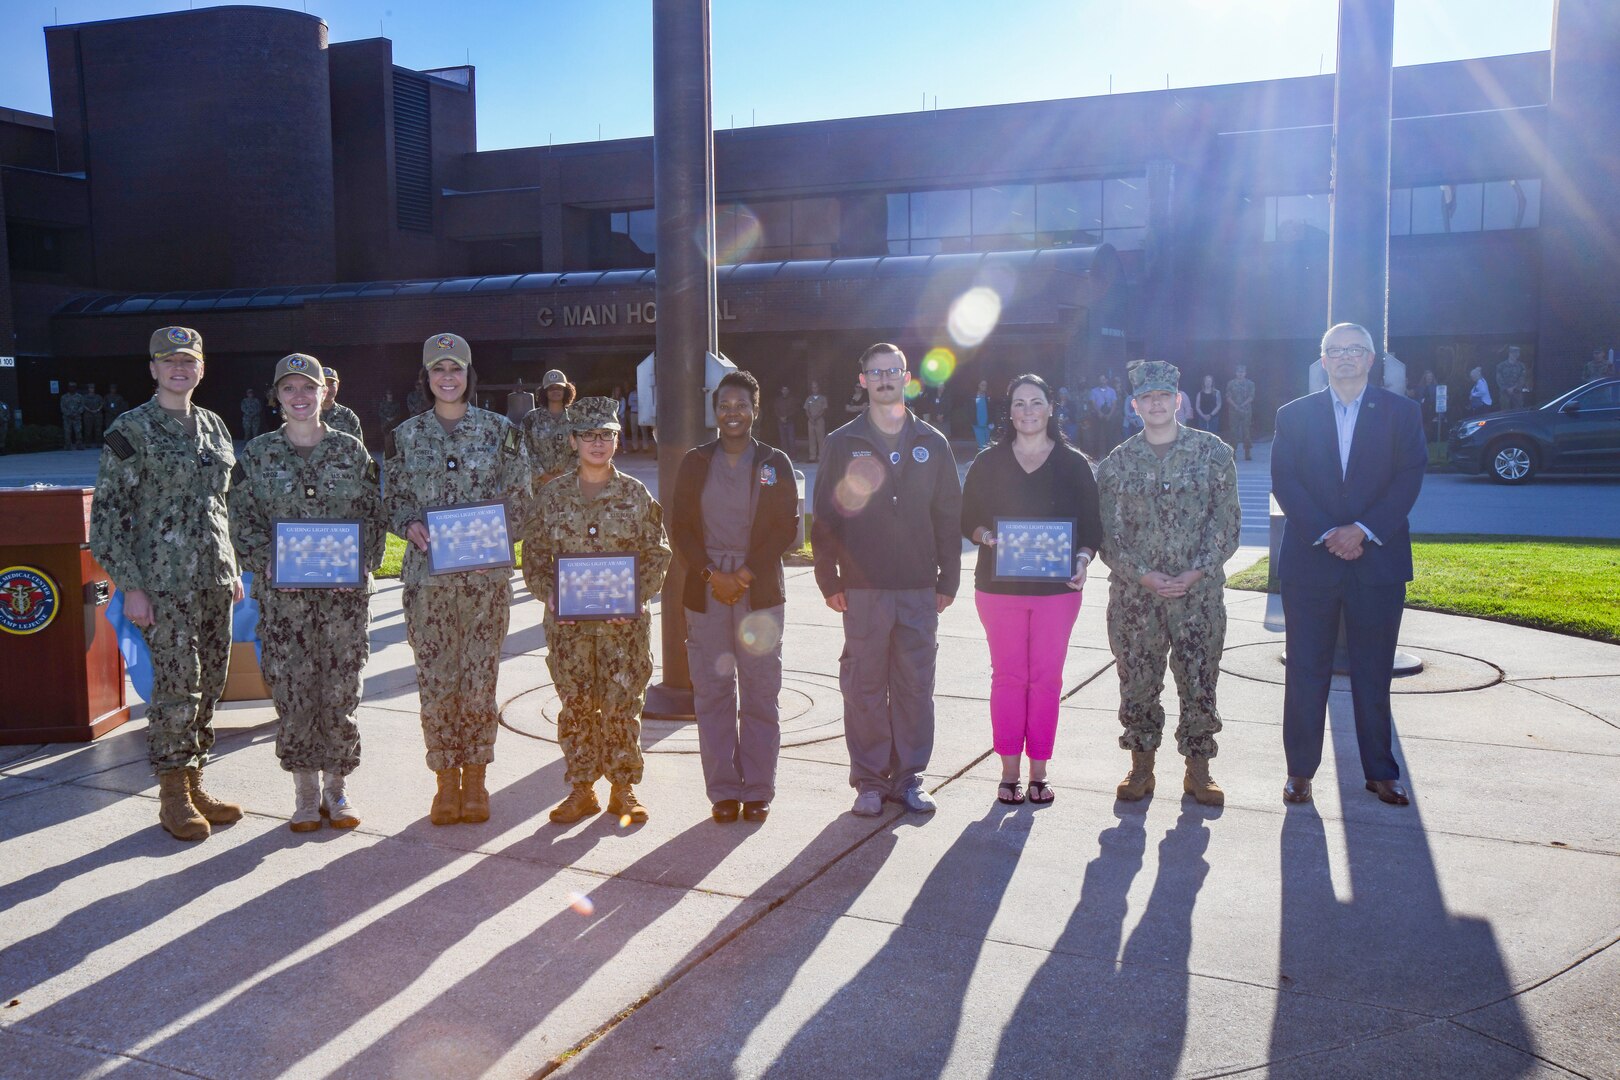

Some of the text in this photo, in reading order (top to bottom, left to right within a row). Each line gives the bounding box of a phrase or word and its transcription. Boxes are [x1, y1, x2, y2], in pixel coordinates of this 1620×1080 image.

[563, 304, 617, 326] MAIN
[3, 358, 13, 366] 100
[2, 573, 51, 596] MEDICAL CENTER
[18, 613, 48, 629] LEJEUNE
